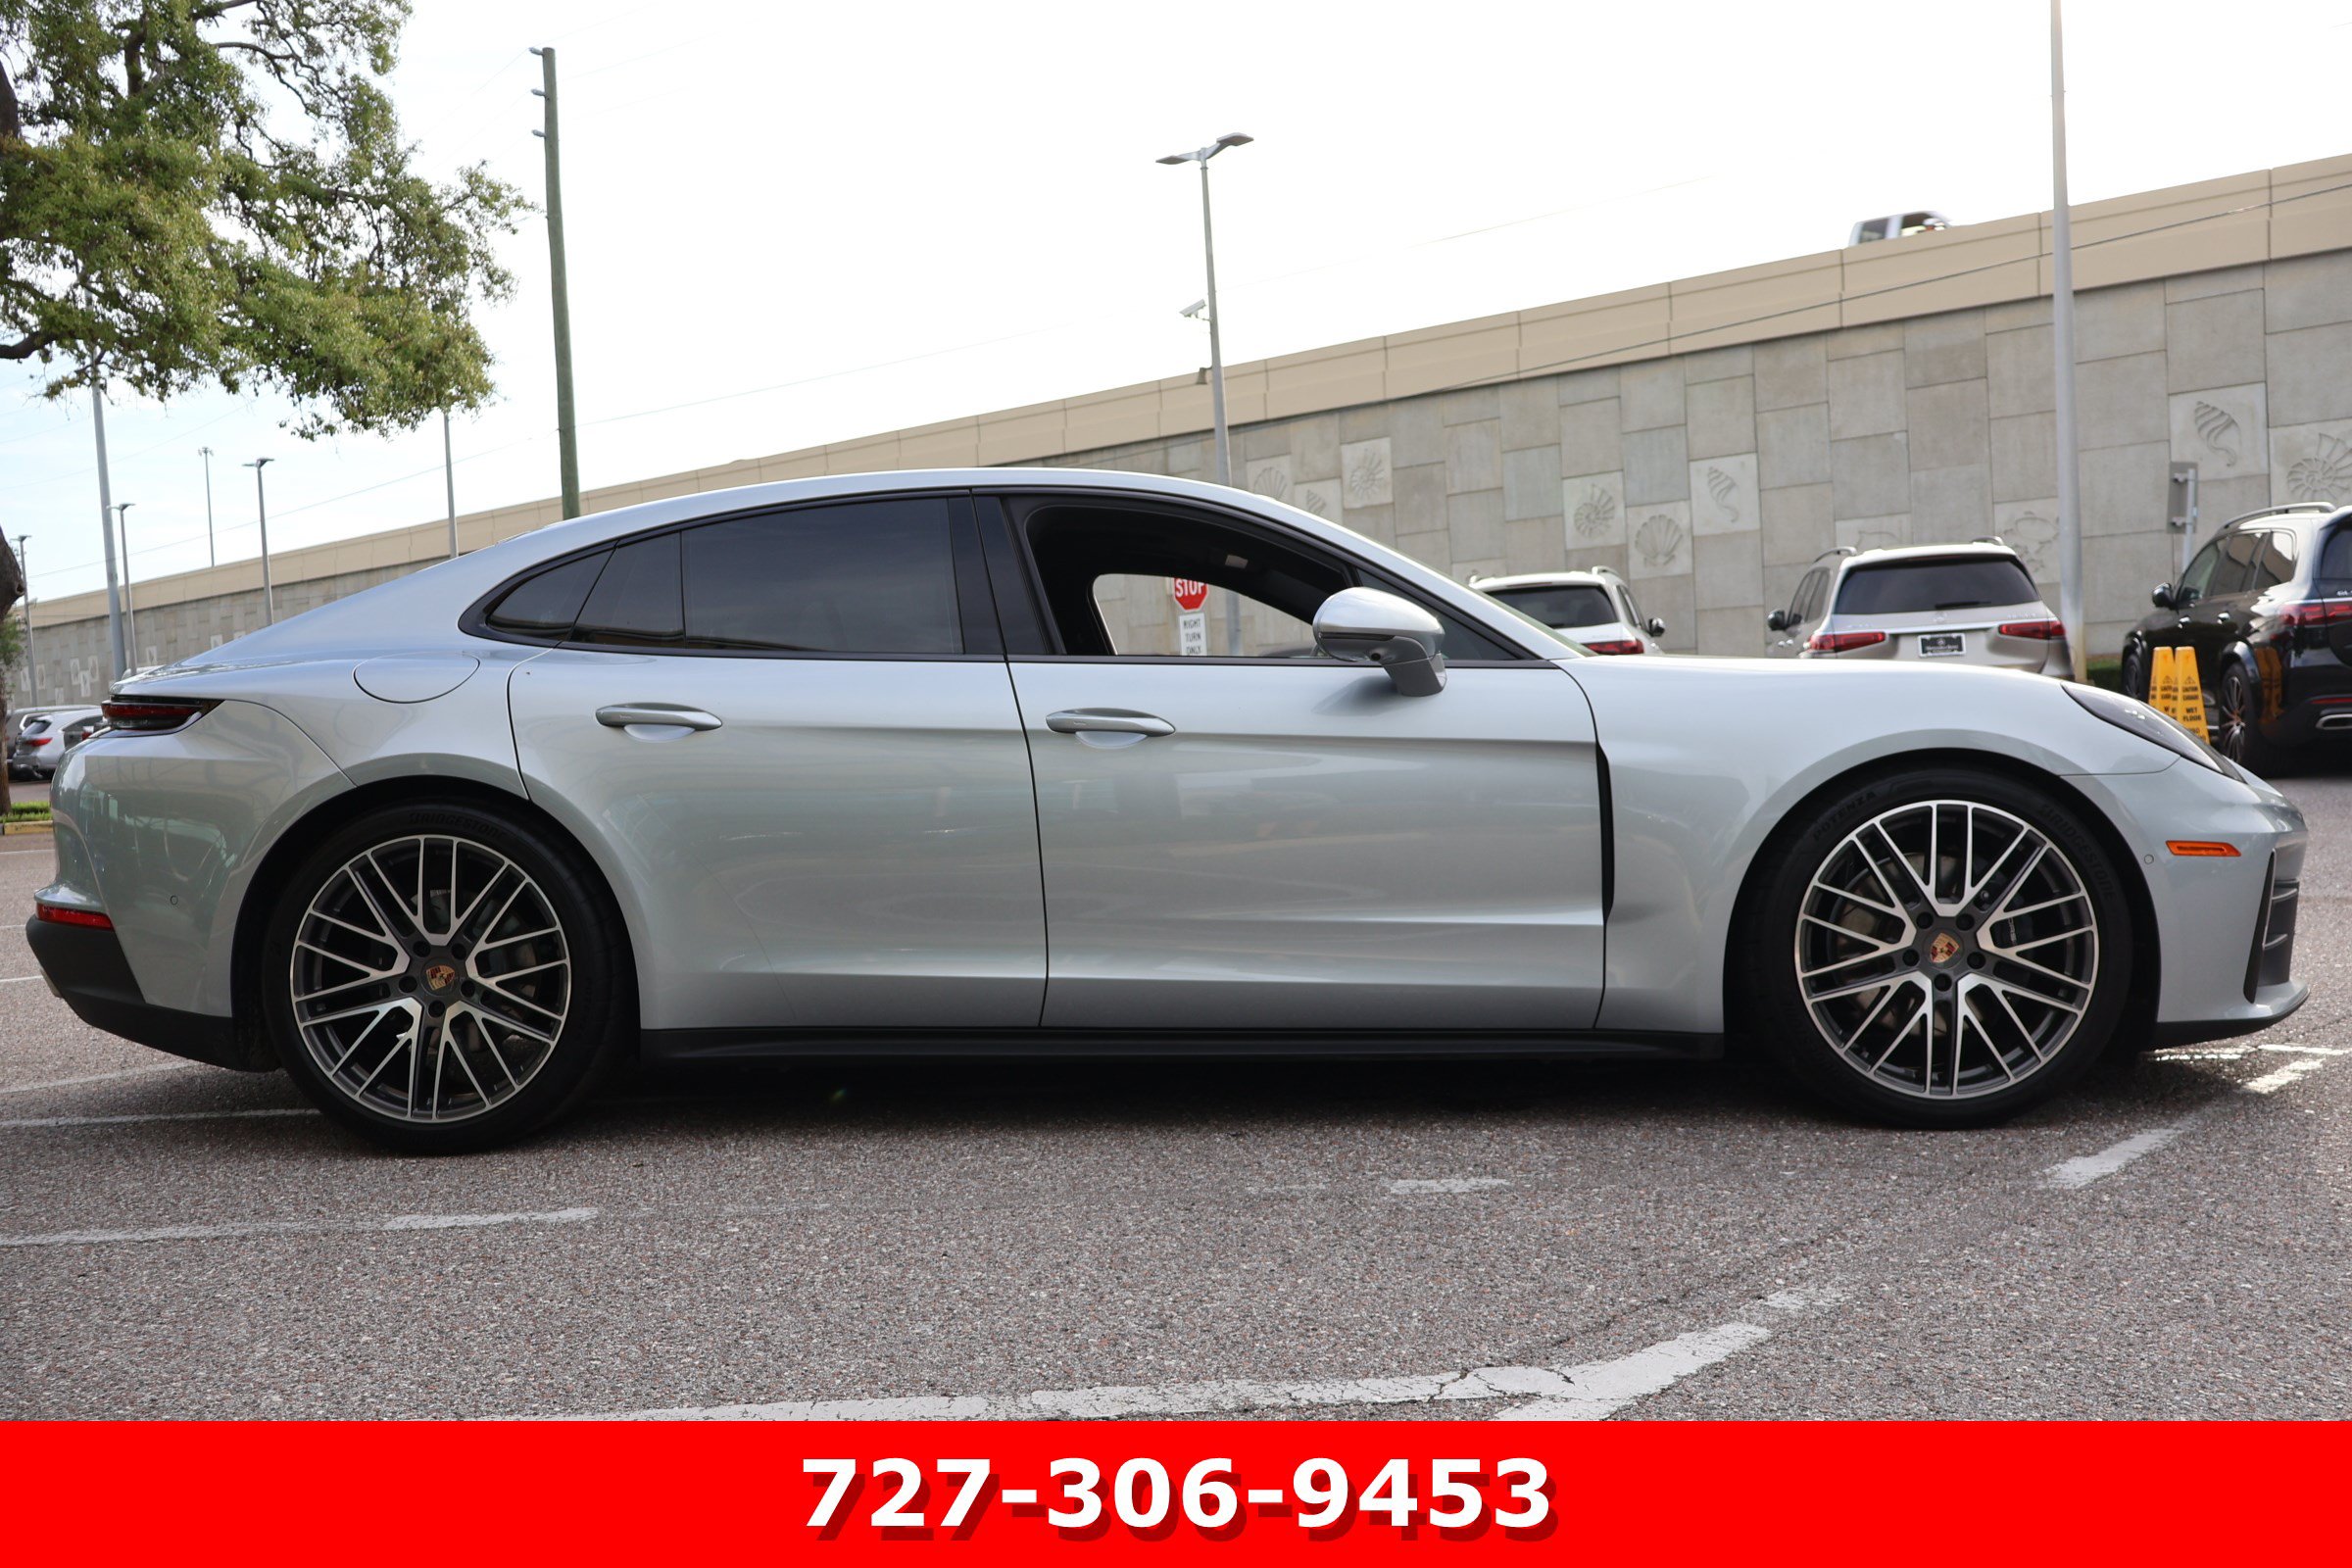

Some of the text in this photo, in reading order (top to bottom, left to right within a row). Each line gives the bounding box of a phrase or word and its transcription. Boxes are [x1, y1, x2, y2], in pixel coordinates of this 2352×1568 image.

[1176, 577, 1204, 598] STOP
[1184, 618, 1200, 629] RIGHT
[1185, 632, 1201, 642] TURN
[2039, 804, 2115, 901] BRIDGESTONE
